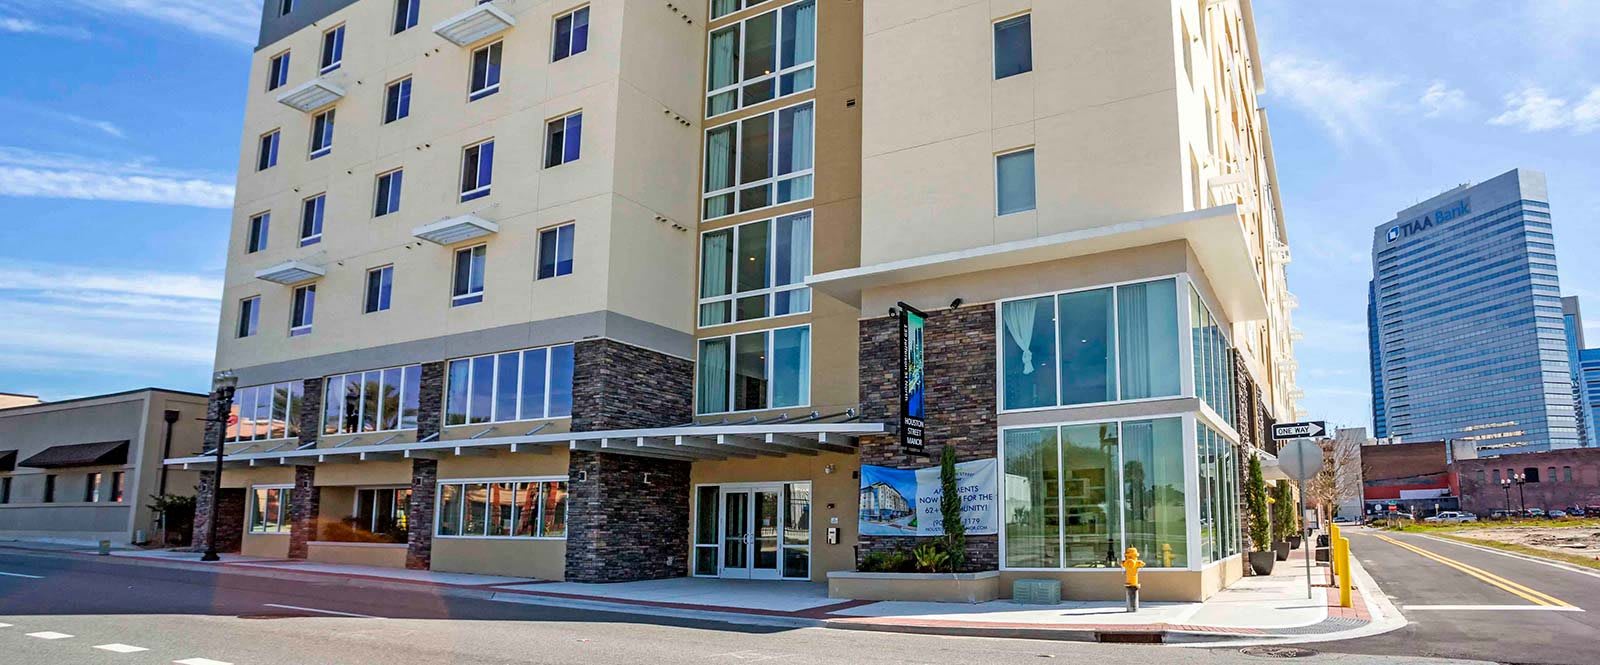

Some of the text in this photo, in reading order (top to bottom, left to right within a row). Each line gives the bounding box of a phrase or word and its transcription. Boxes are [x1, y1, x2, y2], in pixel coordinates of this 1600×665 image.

[1401, 199, 1470, 237] TIAA Bank
[905, 417, 924, 427] HOUSTON
[907, 428, 921, 436] STREET
[907, 437, 922, 446] MANOR
[979, 493, 993, 501] THE
